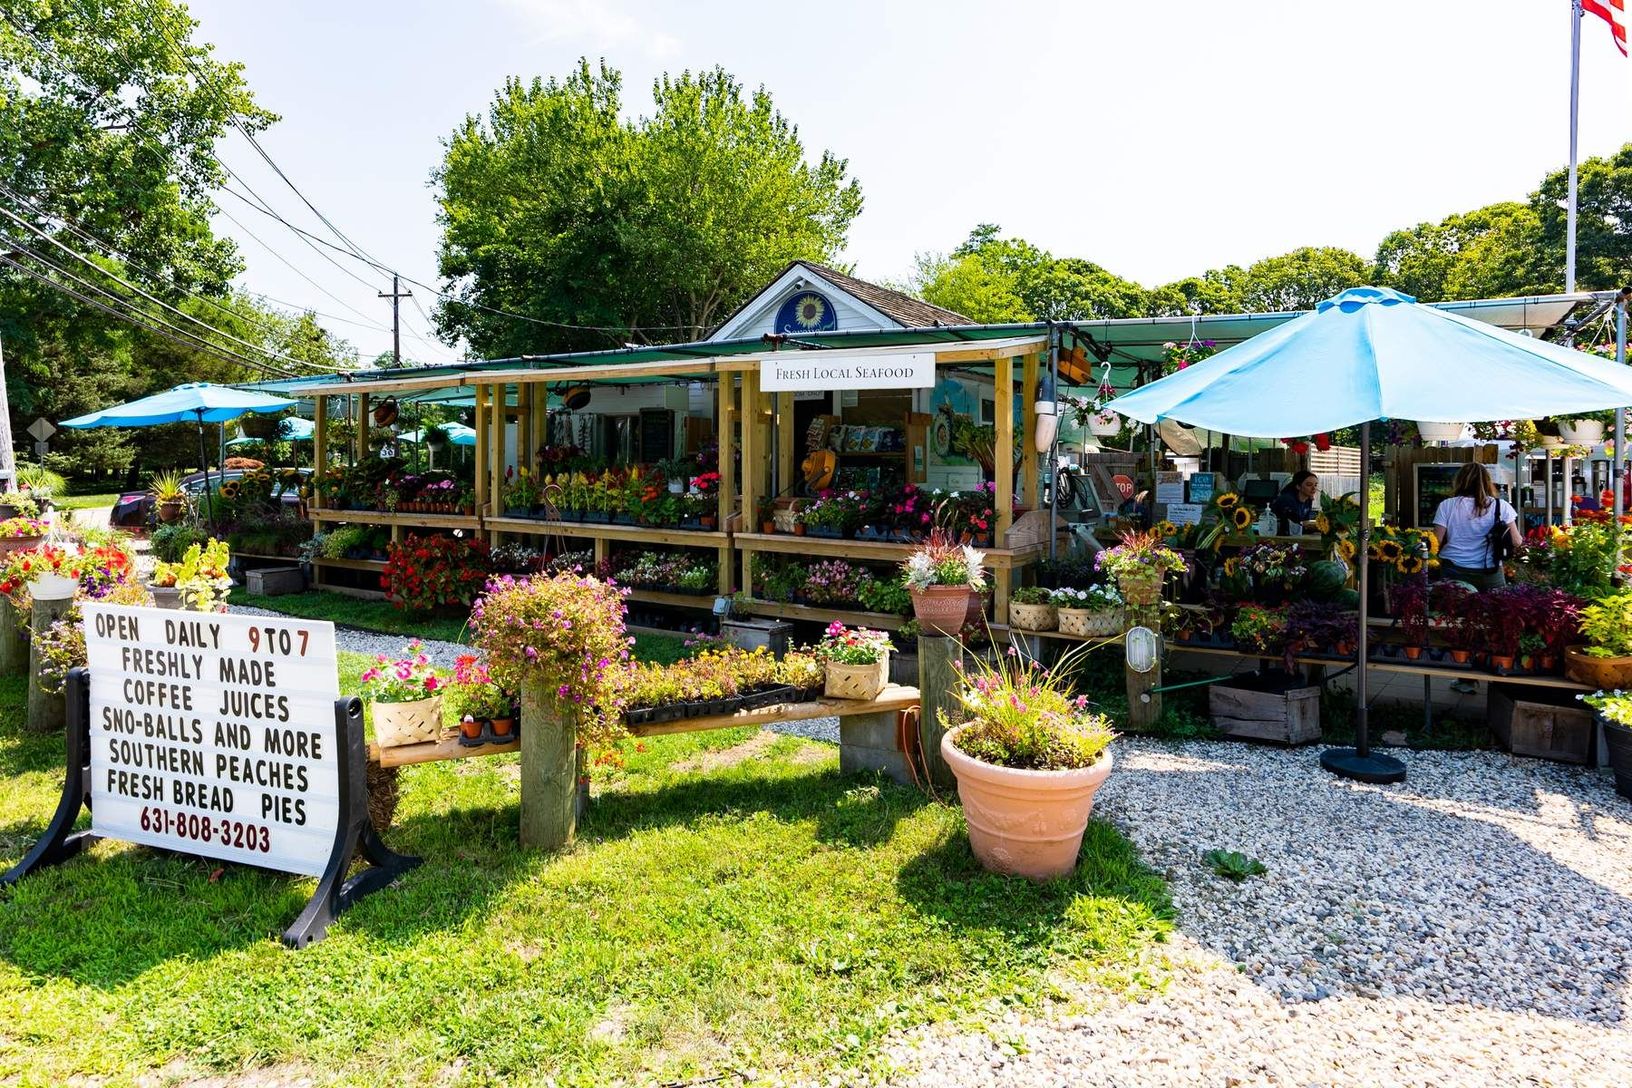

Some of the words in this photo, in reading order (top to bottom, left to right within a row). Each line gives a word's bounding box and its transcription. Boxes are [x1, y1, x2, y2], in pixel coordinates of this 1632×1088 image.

[1115, 482, 1132, 493] TOP
[95, 612, 140, 642] OPEN
[165, 619, 220, 650] DAILY
[122, 647, 203, 680] FRESHLY
[220, 657, 276, 687] MADE
[124, 678, 193, 711] COFFEE
[220, 690, 289, 722] JUICES
[103, 706, 203, 744] SNO-BALLS
[214, 721, 251, 751] AND
[264, 727, 322, 759] MORE
[109, 738, 204, 777] SOUTHERN
[216, 754, 308, 792] PEACHES
[107, 769, 164, 801] FRESH
[173, 779, 234, 813] BREAD
[262, 793, 306, 826] PIES
[140, 806, 270, 852] 631-808-3203
